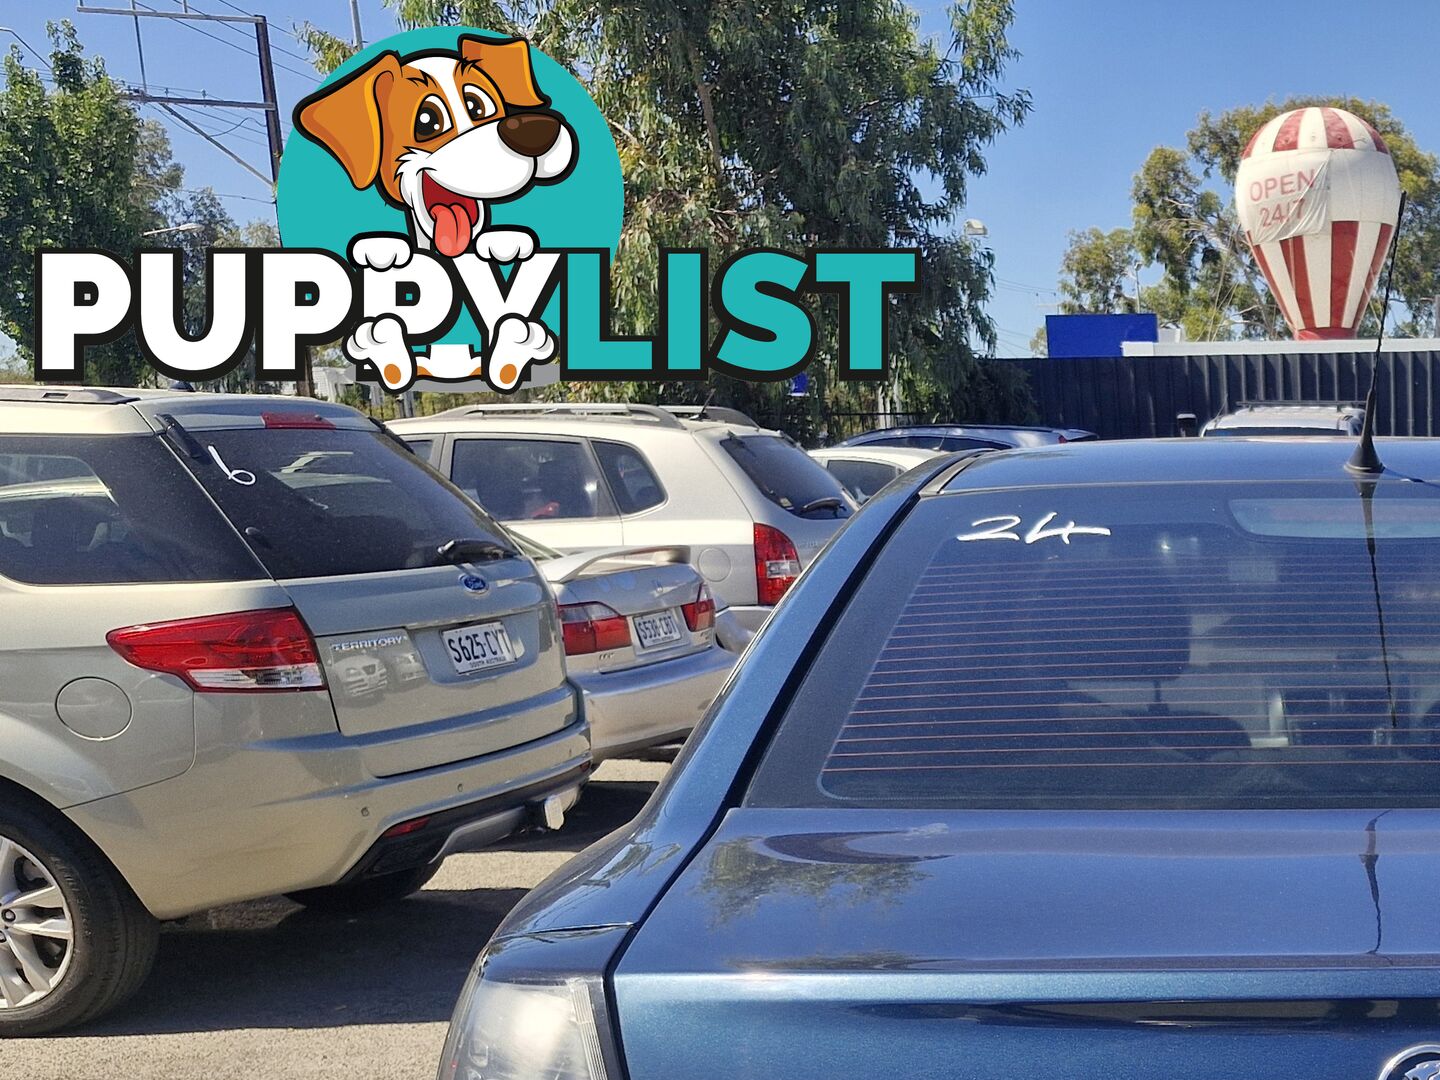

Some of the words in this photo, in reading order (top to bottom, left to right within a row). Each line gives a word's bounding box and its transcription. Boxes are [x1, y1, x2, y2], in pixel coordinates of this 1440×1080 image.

[1250, 169, 1315, 202] OPEN
[1259, 199, 1305, 228] 24/7
[208, 445, 256, 486] 6
[957, 511, 1112, 545] 24
[331, 636, 402, 651] TERRITORY
